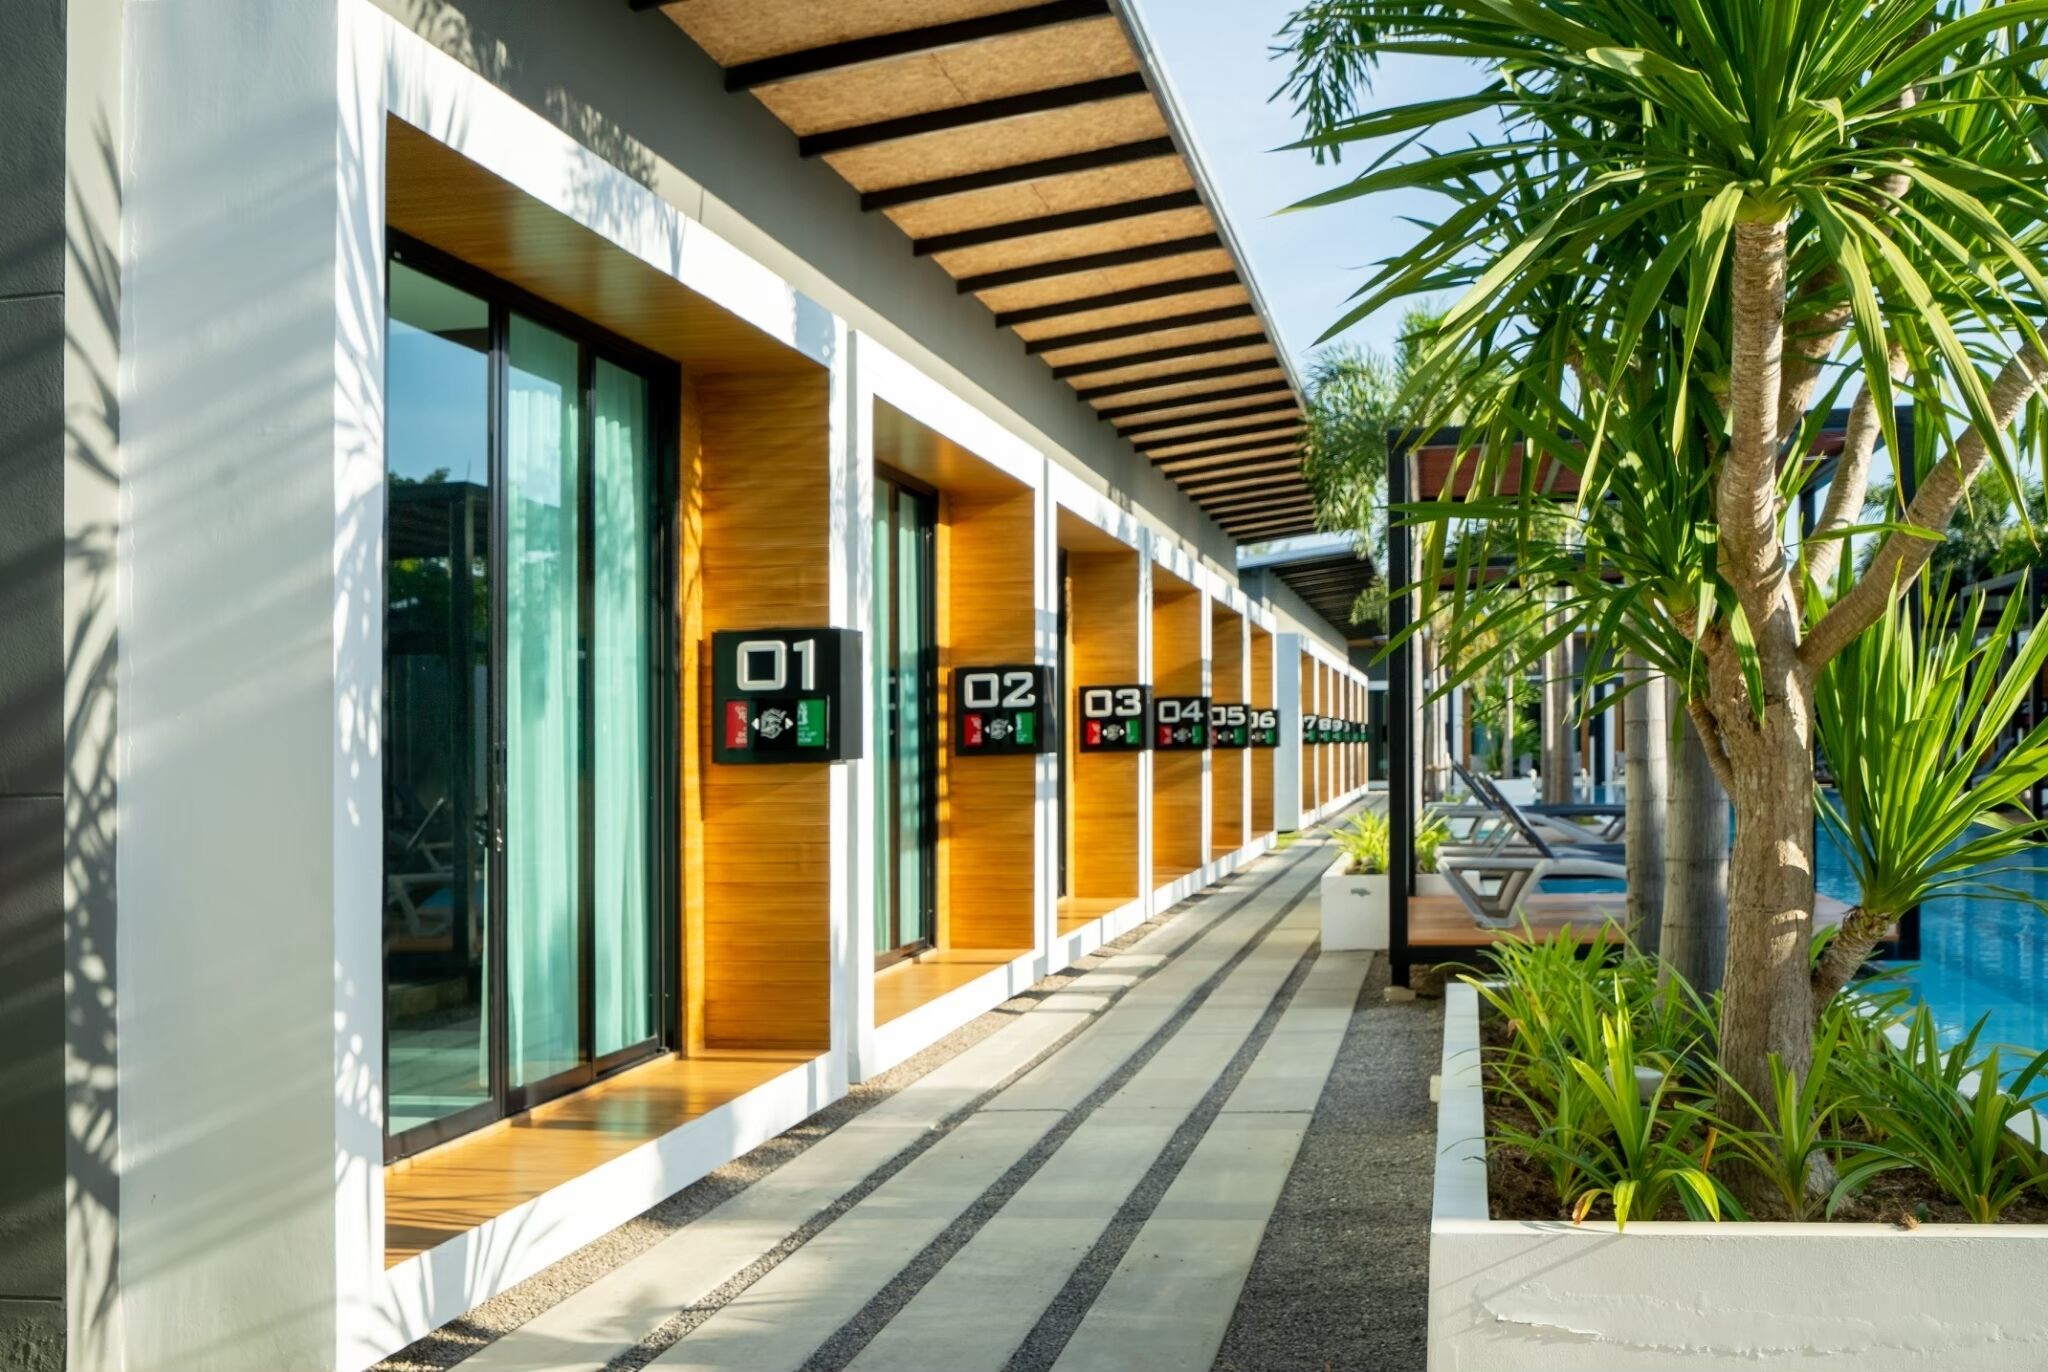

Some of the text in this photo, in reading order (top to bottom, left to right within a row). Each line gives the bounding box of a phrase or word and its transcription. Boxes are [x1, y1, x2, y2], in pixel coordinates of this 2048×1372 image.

[737, 638, 815, 691] 01
[964, 671, 1036, 709] 02
[1084, 688, 1142, 718] 03
[1158, 699, 1204, 723] 04
